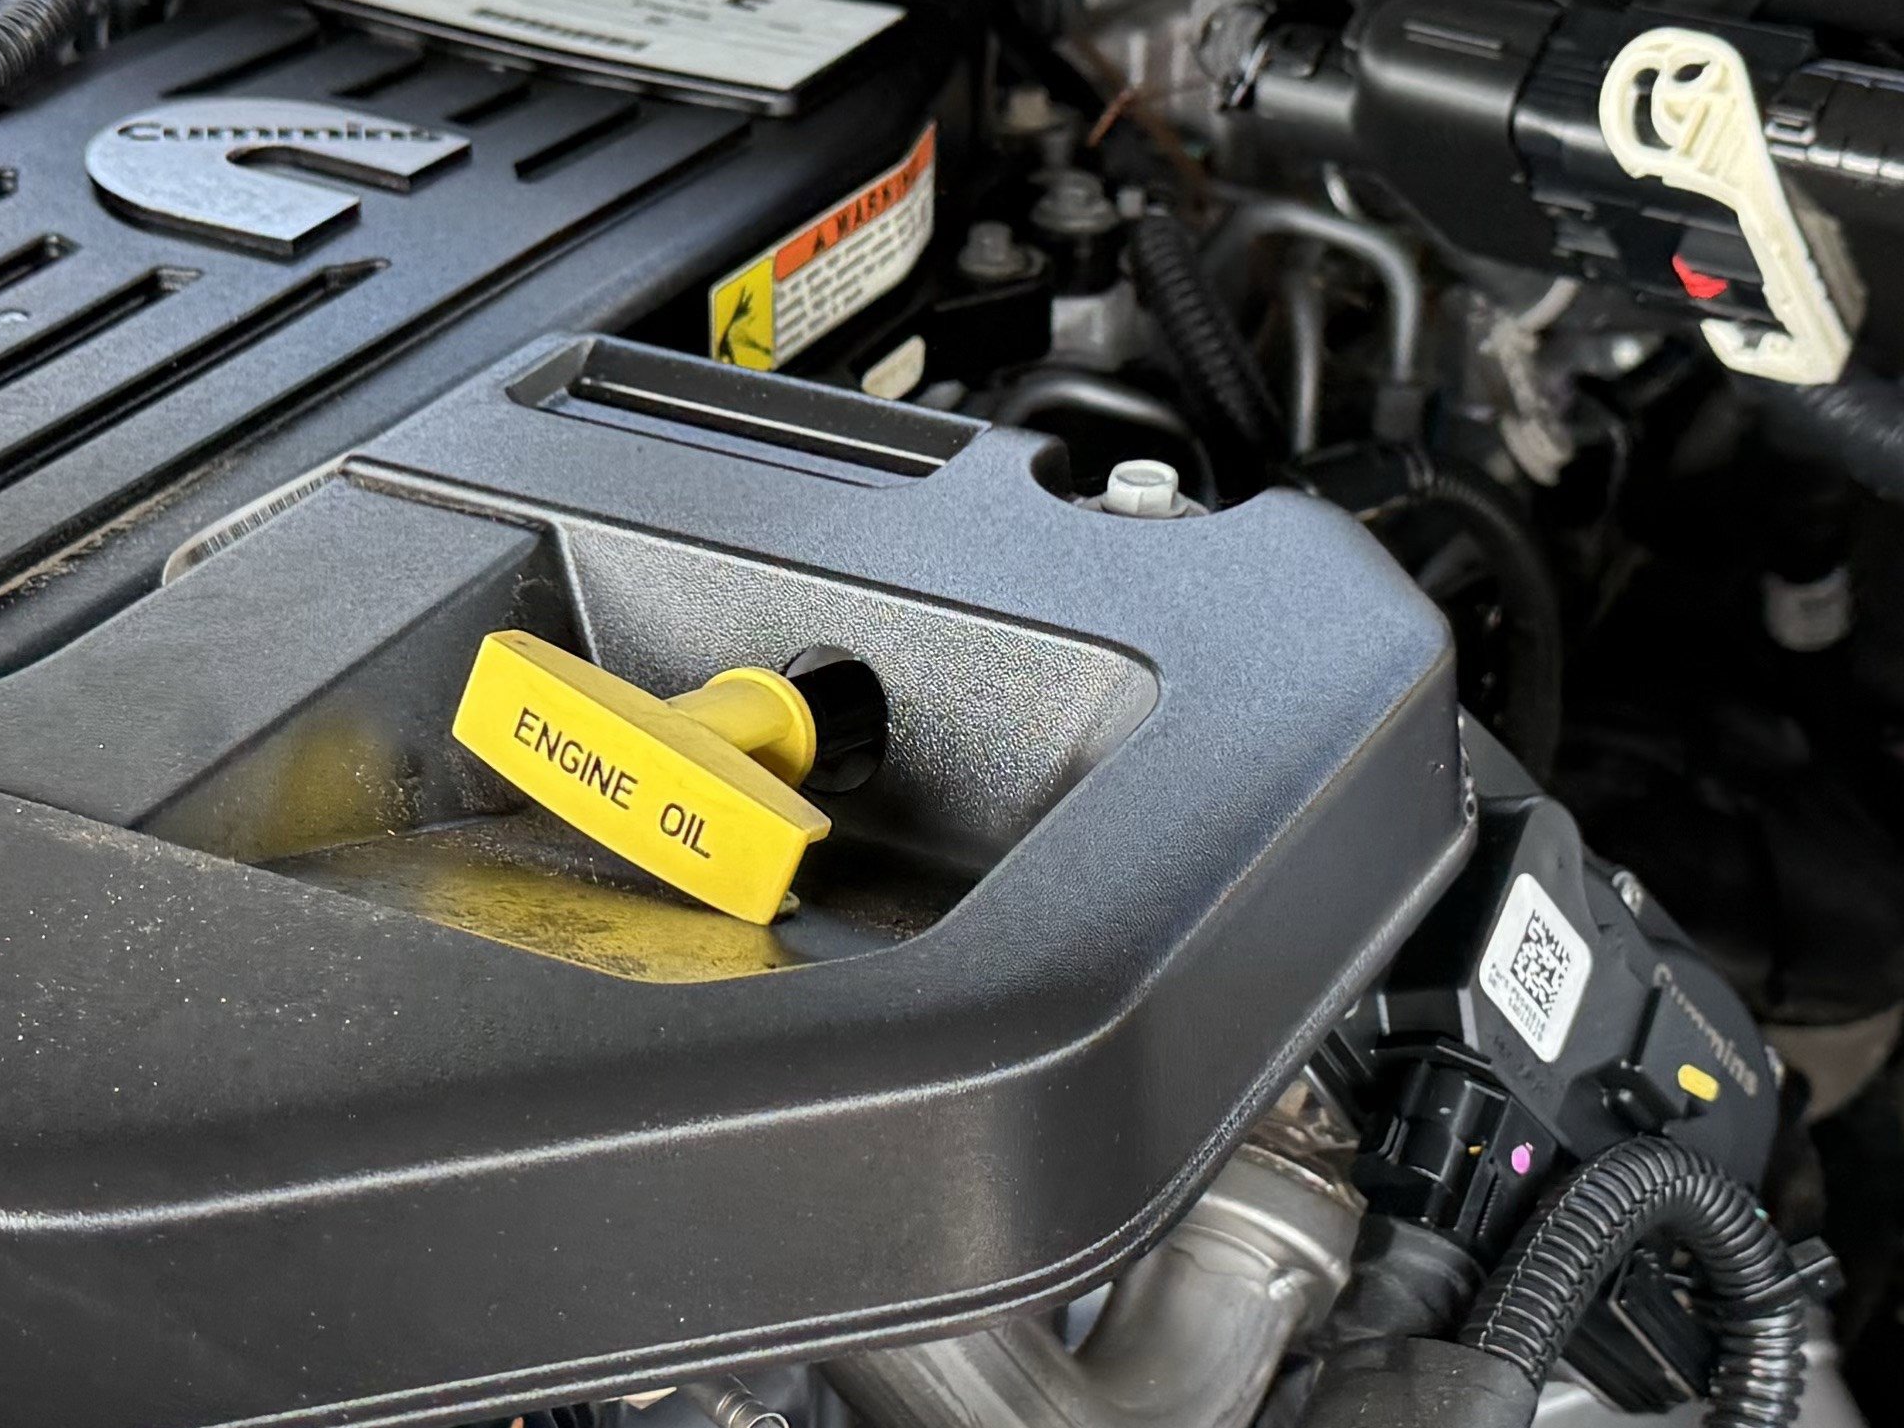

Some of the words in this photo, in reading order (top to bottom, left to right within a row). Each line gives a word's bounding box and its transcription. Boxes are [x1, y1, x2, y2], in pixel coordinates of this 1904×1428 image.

[116, 119, 444, 143] Cummins
[513, 706, 639, 811] ENGINE
[659, 802, 712, 859] OIL
